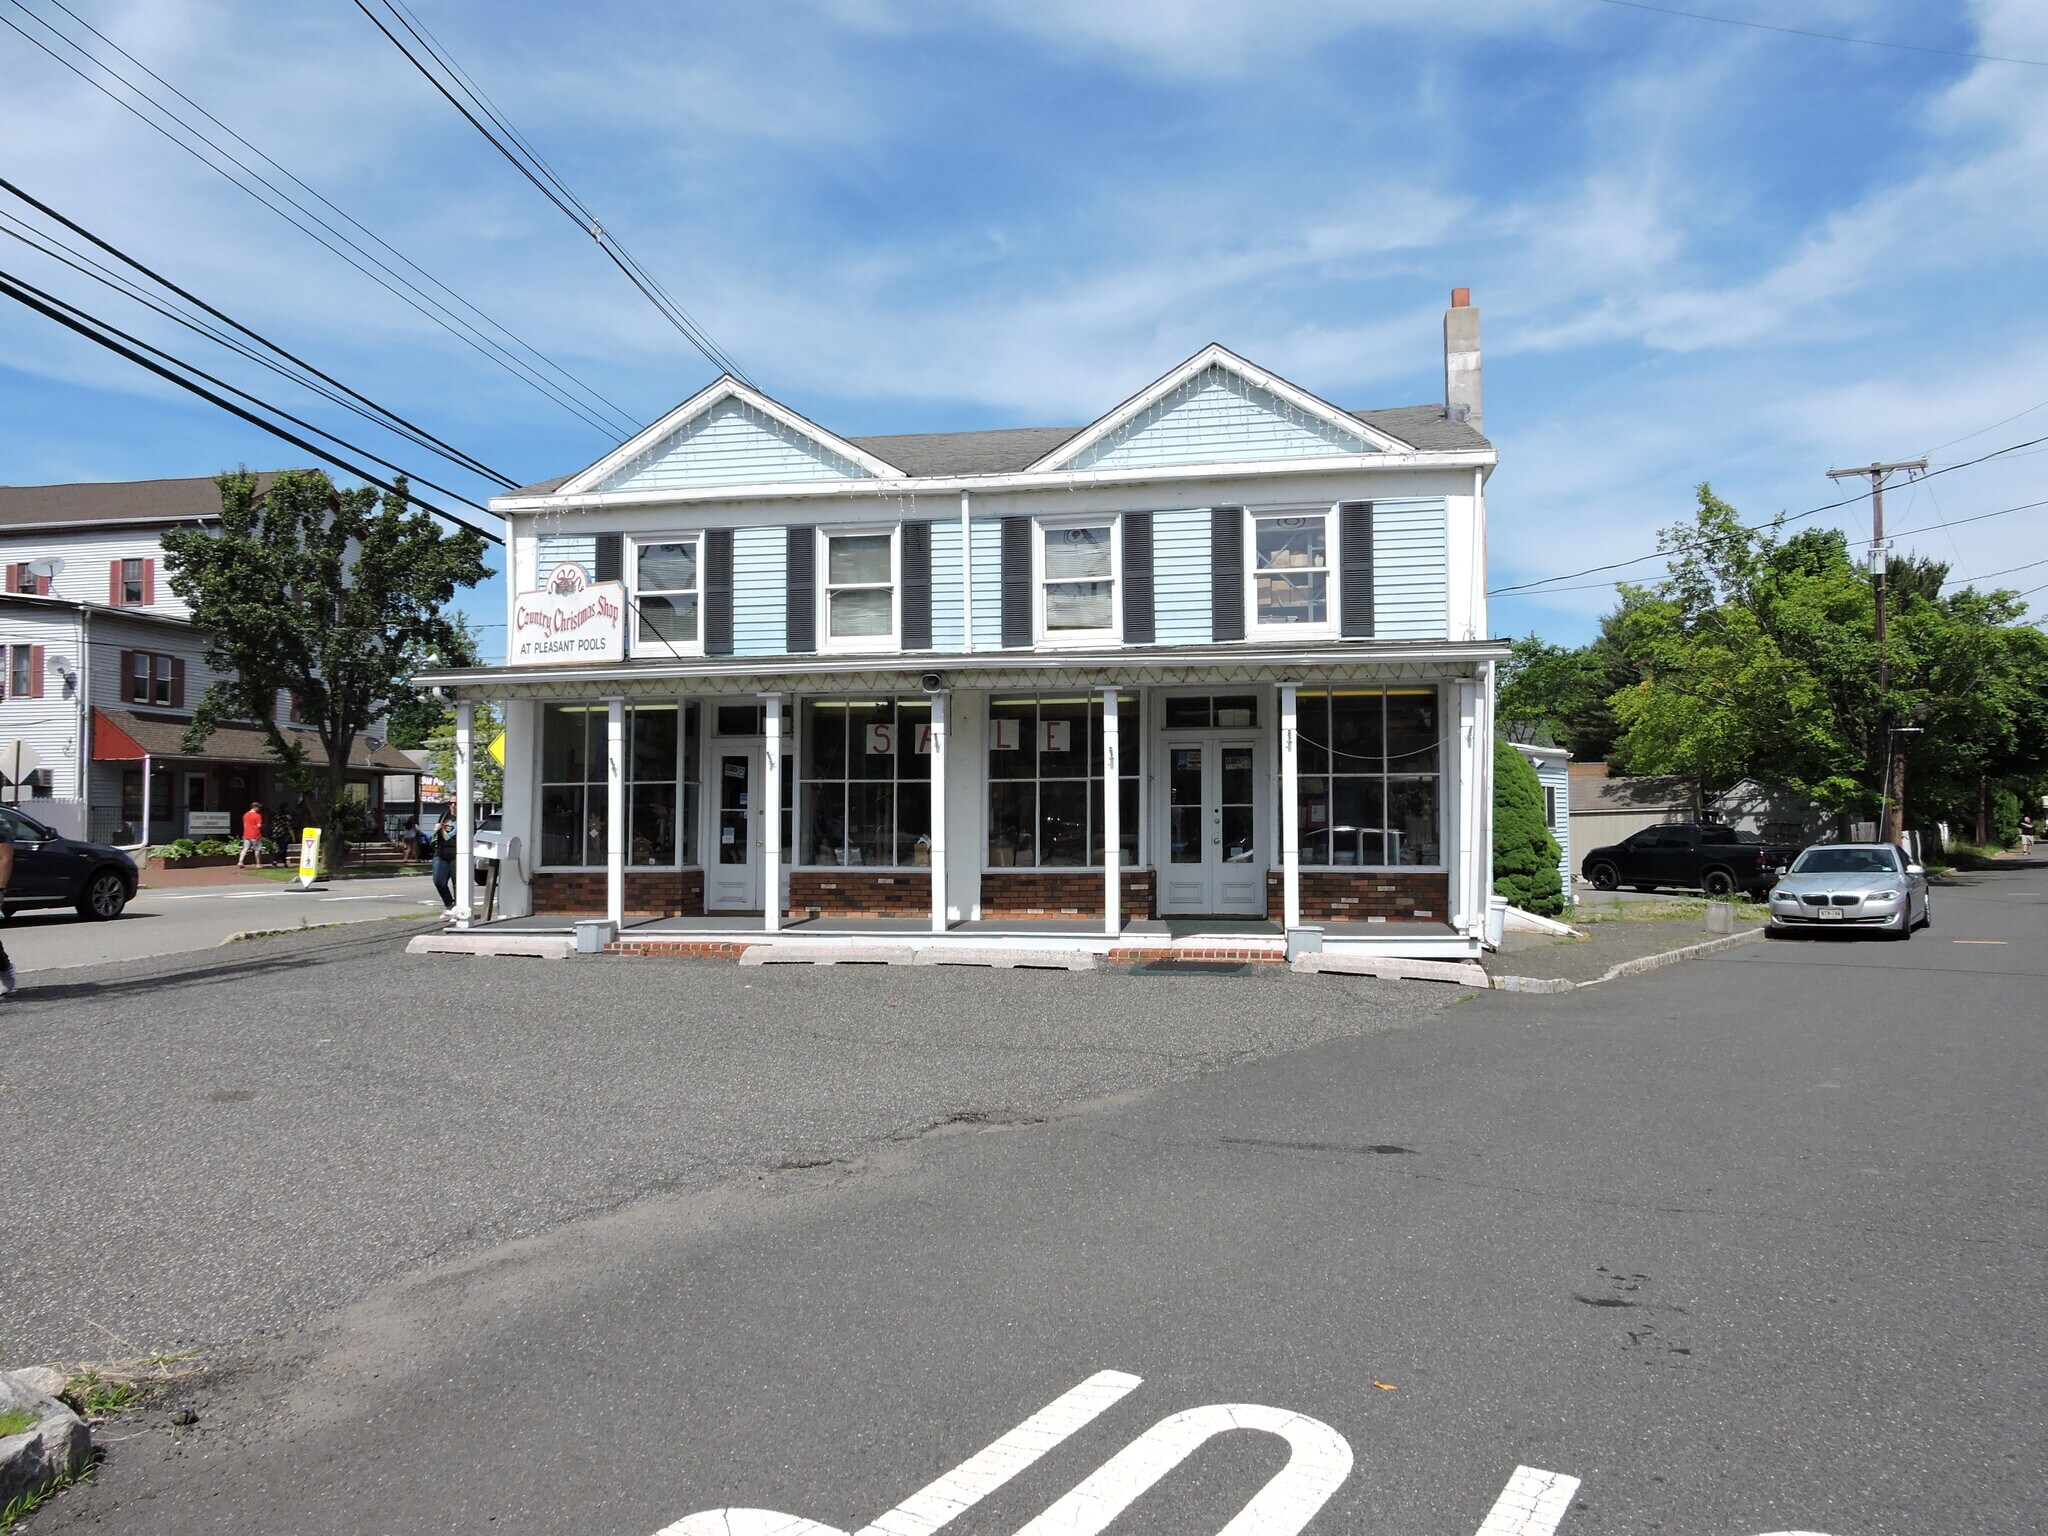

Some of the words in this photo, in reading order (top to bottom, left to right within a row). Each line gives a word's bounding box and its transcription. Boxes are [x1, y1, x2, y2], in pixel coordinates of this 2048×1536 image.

[517, 606, 552, 638] Country
[554, 603, 596, 632] Christmas
[597, 595, 619, 628] Shop
[520, 642, 532, 654] AT
[534, 640, 575, 654] PLEASANT
[578, 638, 606, 651] POOLS
